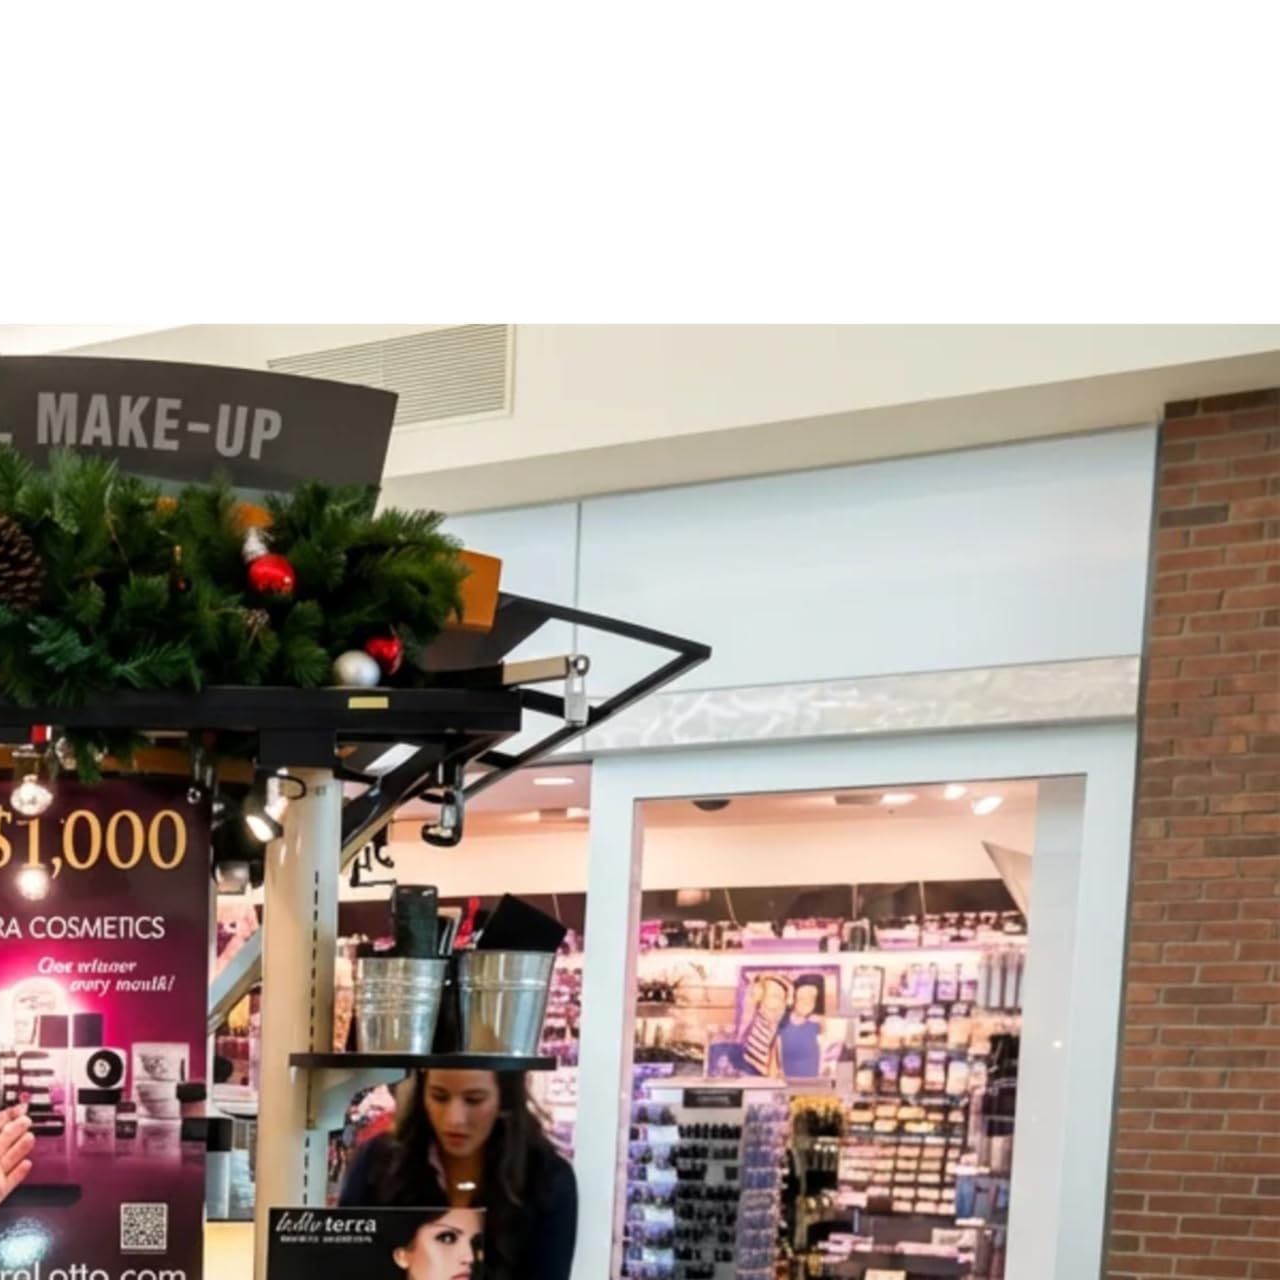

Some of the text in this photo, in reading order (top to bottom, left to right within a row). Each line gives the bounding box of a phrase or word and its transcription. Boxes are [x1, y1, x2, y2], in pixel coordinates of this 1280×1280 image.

[36, 391, 283, 460] MAKE-UP
[28, 916, 166, 940] COSMETICS
[324, 1216, 376, 1232] terra
